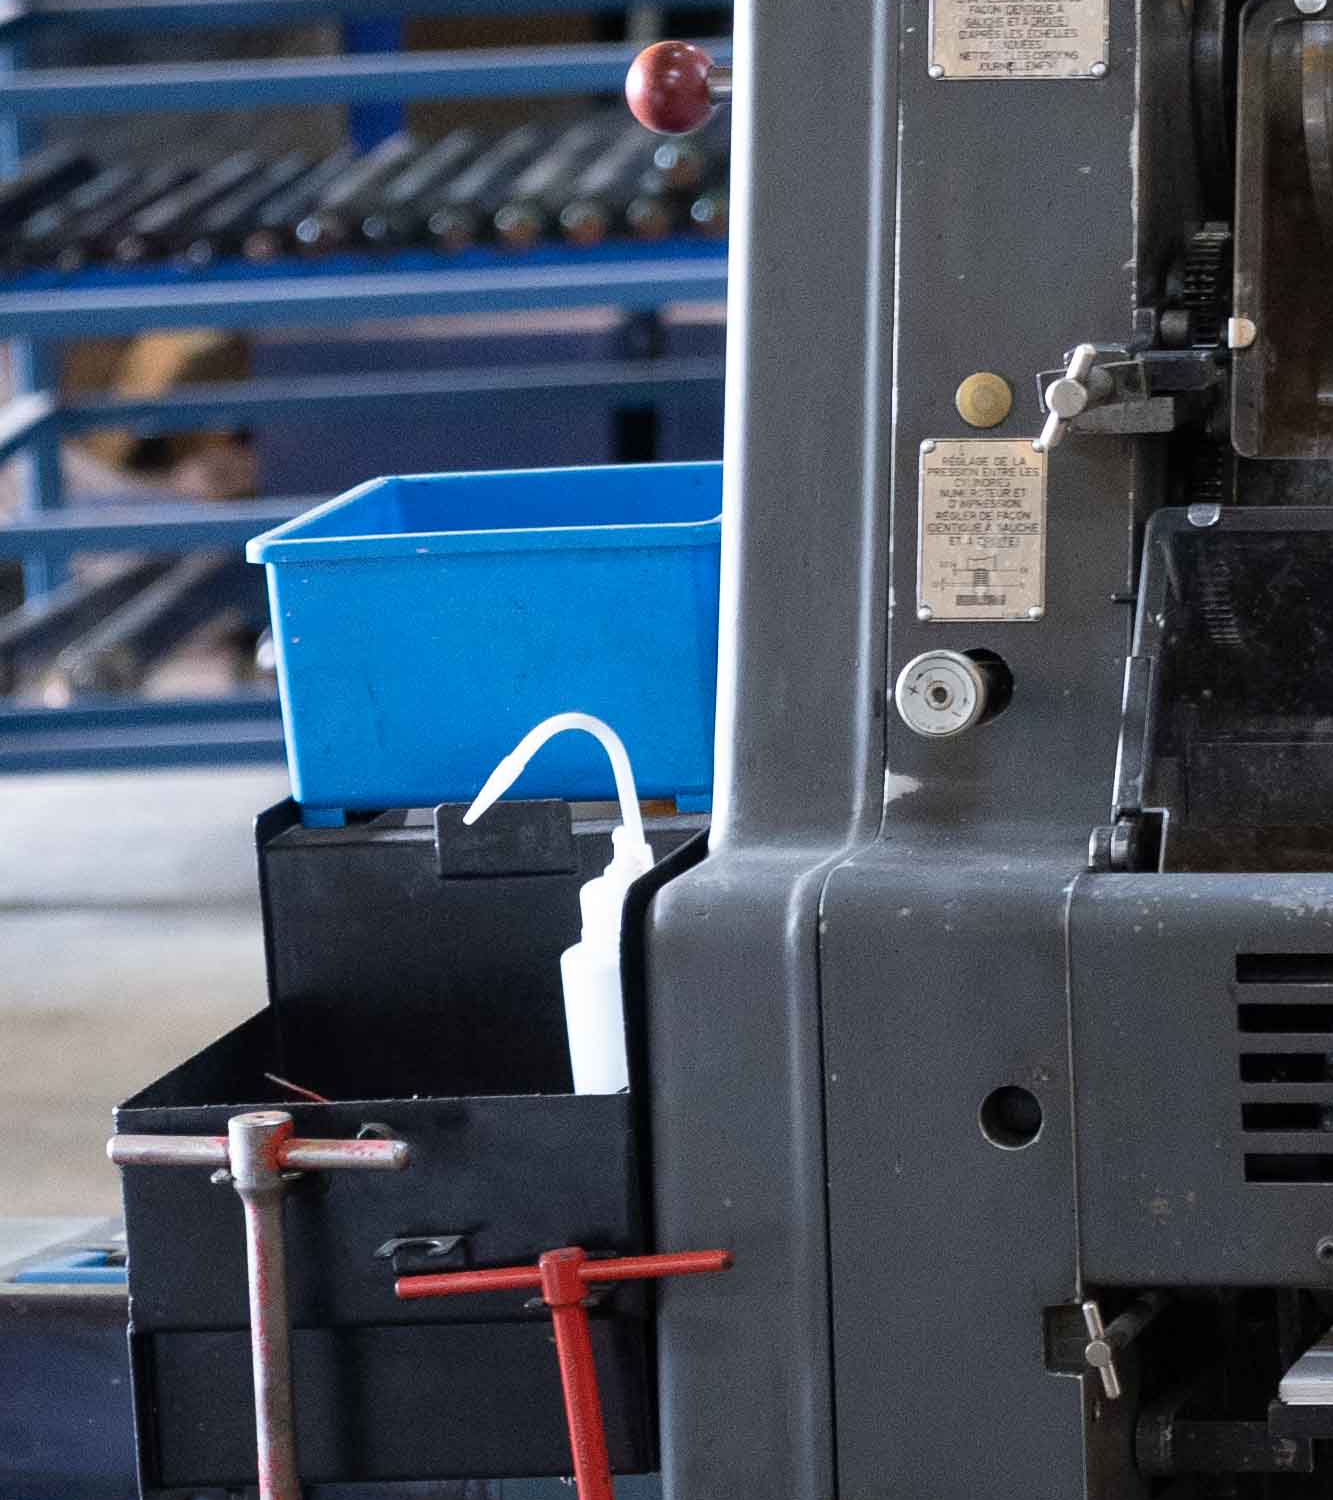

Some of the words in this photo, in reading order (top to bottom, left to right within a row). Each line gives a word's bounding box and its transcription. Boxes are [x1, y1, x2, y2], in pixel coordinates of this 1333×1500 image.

[993, 456, 1008, 466] DE
[1012, 456, 1026, 466] LA
[1020, 467, 1040, 477] LES
[979, 511, 993, 521] DE
